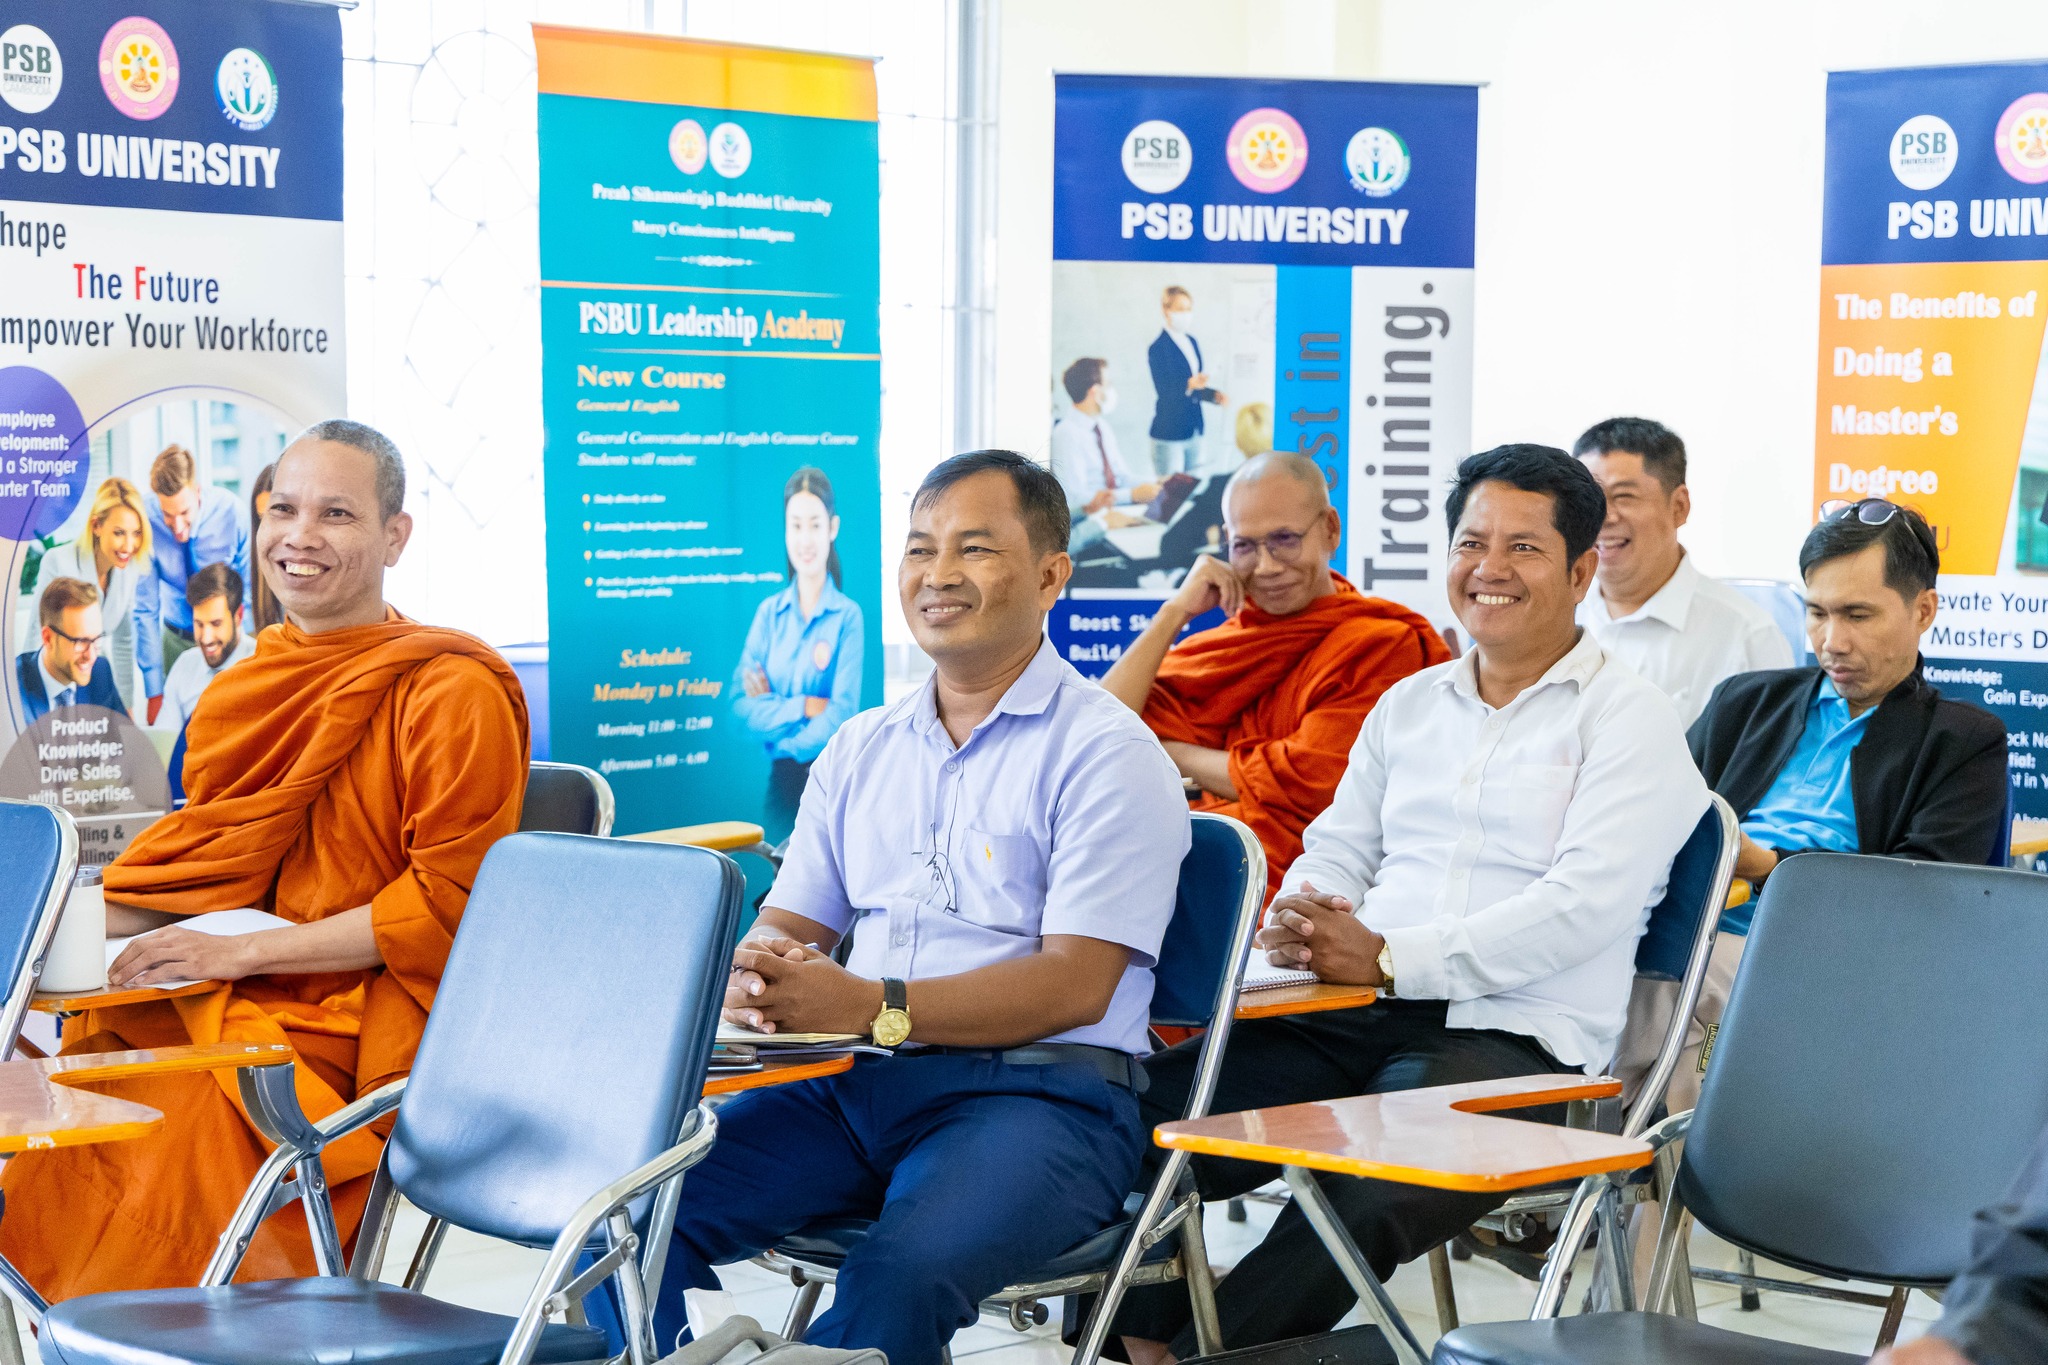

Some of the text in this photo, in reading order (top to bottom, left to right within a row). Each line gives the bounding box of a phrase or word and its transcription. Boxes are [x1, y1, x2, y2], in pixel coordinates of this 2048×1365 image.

[3, 43, 51, 73] PSB
[4, 73, 51, 85] UNIVERSITY
[1134, 138, 1180, 159] PSB
[1901, 133, 1947, 155] PSB
[0, 126, 281, 188] PSB UNIVERSITY
[1121, 202, 1410, 245] PSB UNIVERSITY
[1888, 200, 1959, 239] PSB
[73, 264, 219, 303] The Future
[1834, 290, 2038, 320] The Benefits of
[1, 313, 328, 353] mpower Your Workforce
[579, 301, 846, 349] PSBU Leadership Academy
[1285, 333, 1340, 381] in
[1833, 346, 1953, 383] Doing a
[577, 365, 726, 389] New Course
[1831, 404, 1959, 436] Master's
[1363, 283, 1450, 591] Training.
[6, 460, 16, 474] a
[19, 457, 79, 477] Stronger
[31, 480, 71, 497] Team
[1828, 463, 1939, 498] Degree
[2001, 592, 2048, 613] Your
[1069, 614, 1122, 632] Boost
[1931, 626, 2022, 648] Master's
[619, 647, 692, 668] Schedule:
[1069, 644, 1122, 662] Build
[1922, 666, 2003, 687] Knowledge:
[592, 677, 723, 704] Monday to Friday
[1983, 688, 2048, 710] Gain Exp
[51, 716, 109, 737] Product
[38, 740, 124, 761] Knowledge:
[40, 763, 121, 784] Drive Sales
[62, 785, 135, 806] Expertise.
[113, 824, 124, 840] &
